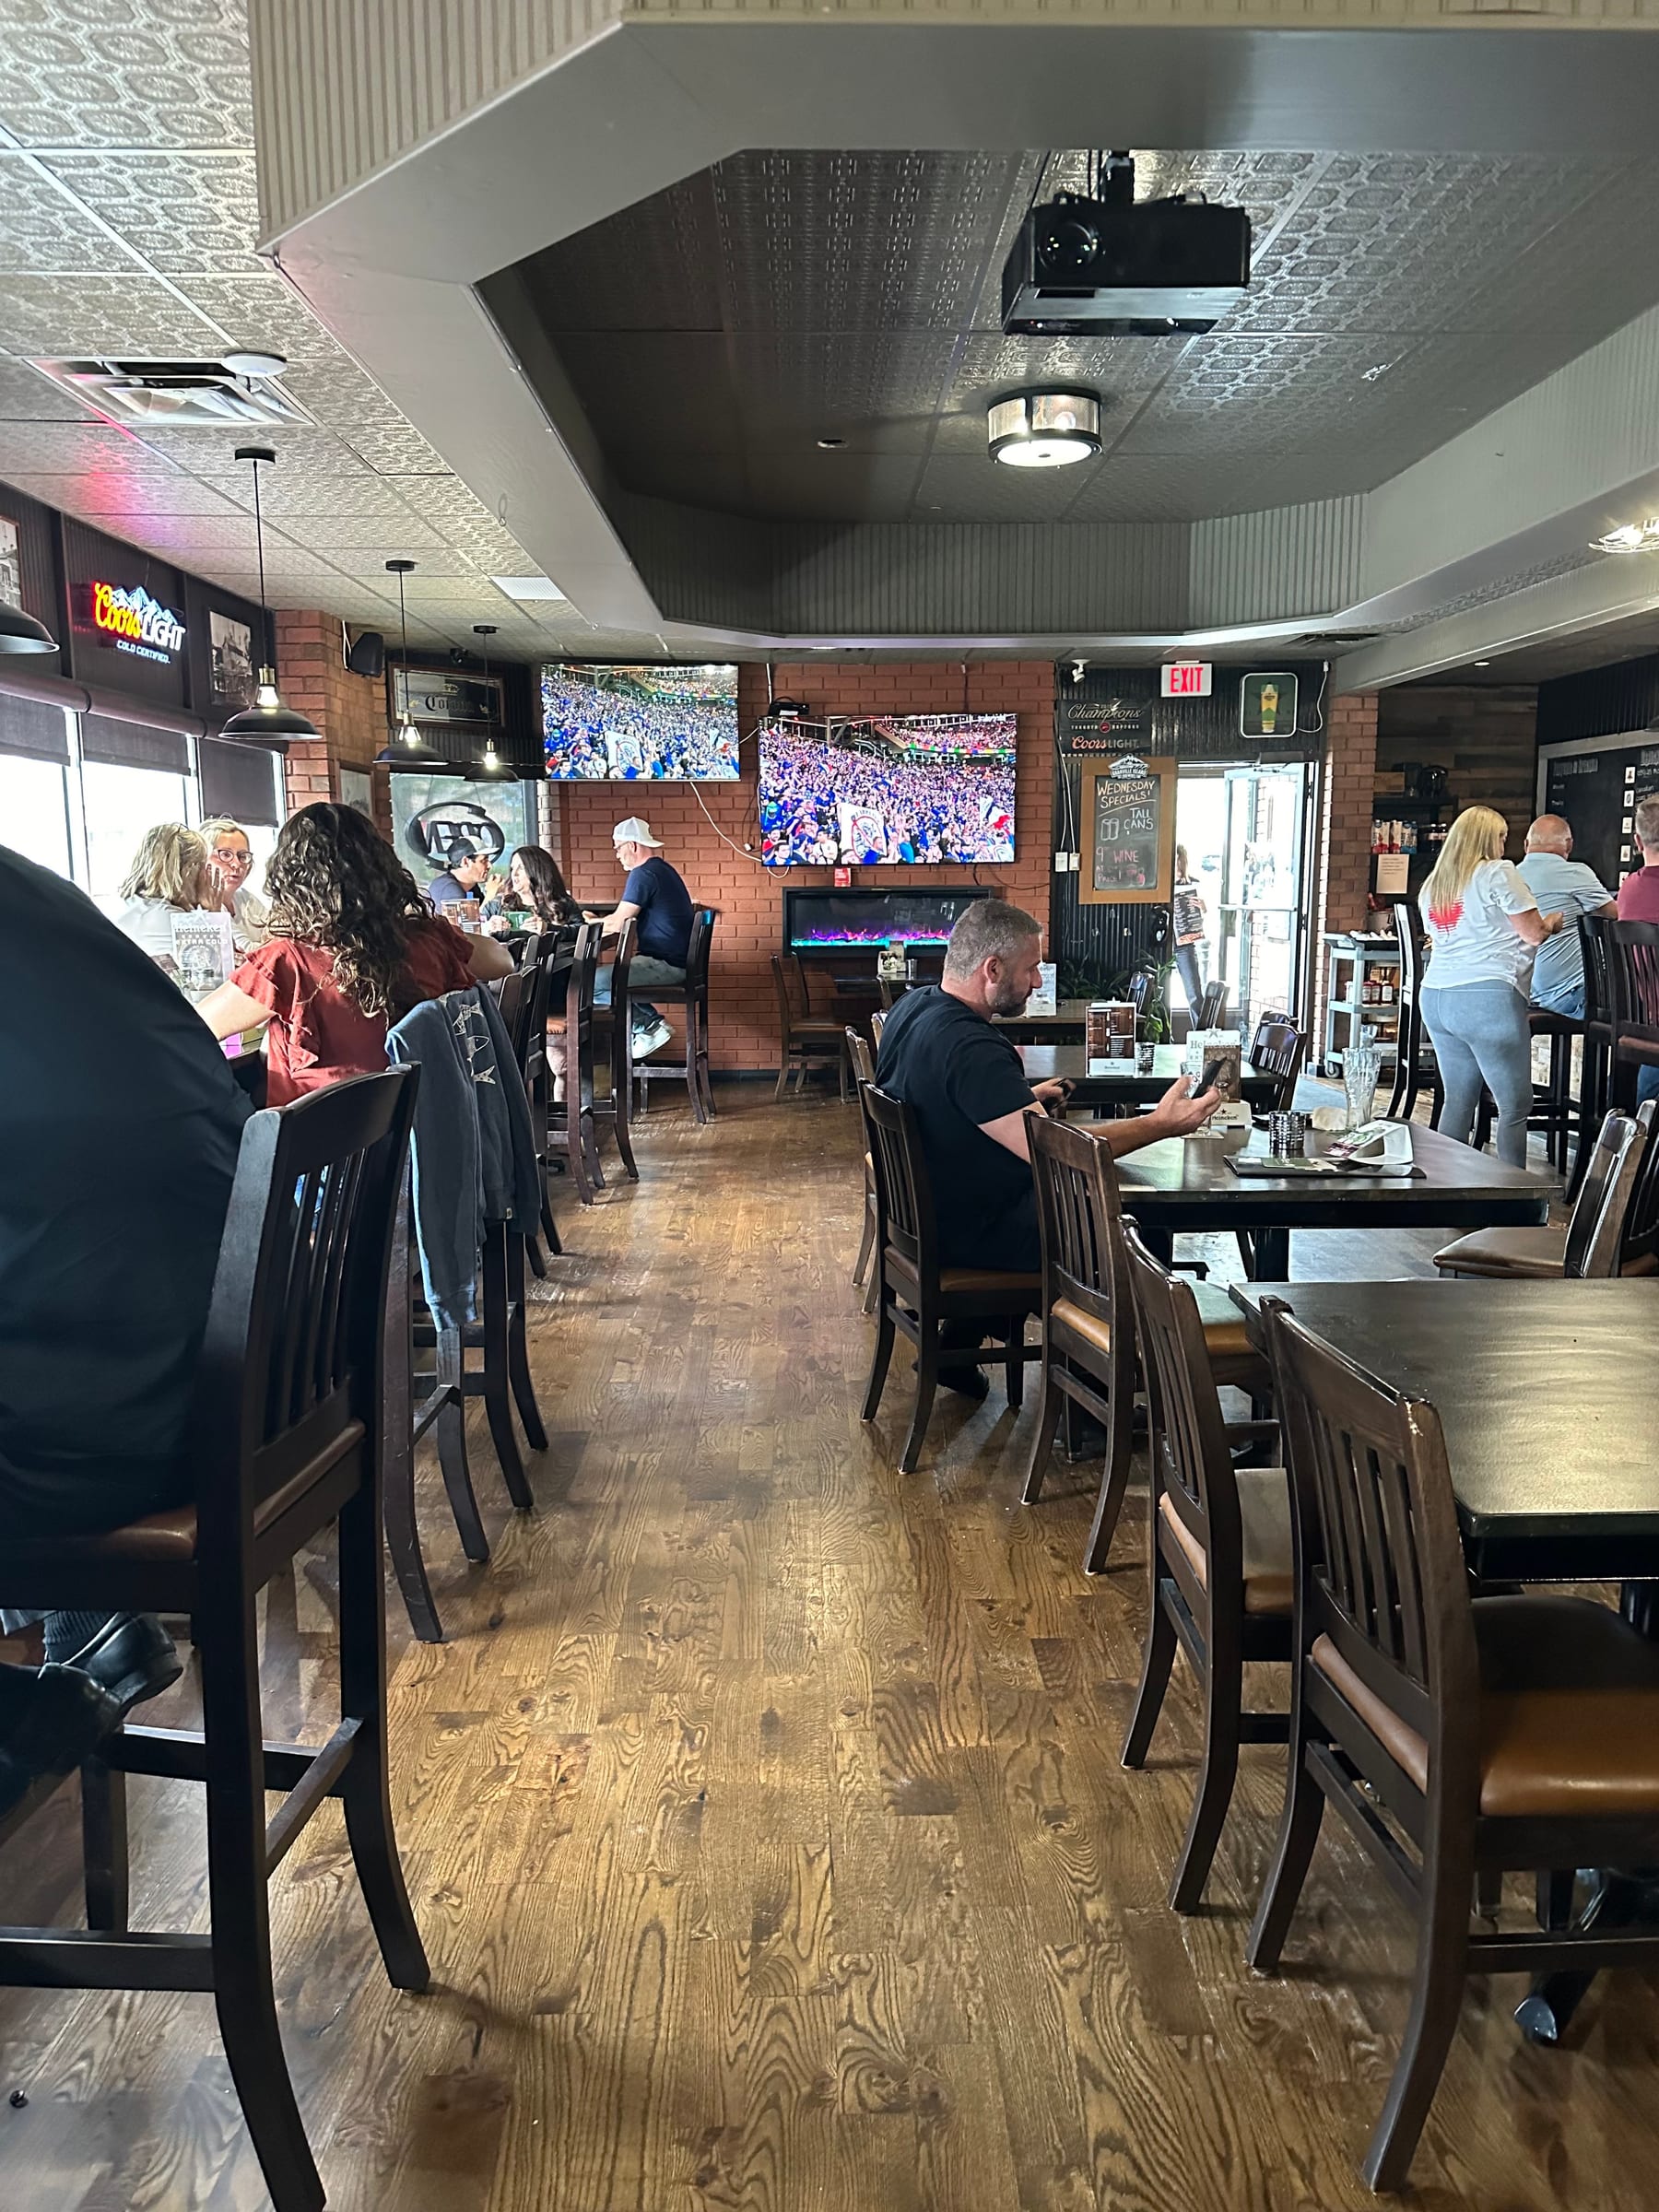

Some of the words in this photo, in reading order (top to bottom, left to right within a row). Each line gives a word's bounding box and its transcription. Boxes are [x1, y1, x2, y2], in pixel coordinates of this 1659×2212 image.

[94, 582, 142, 640] Coors
[141, 612, 186, 651] LIGHT
[116, 640, 136, 653] COLD
[1170, 667, 1204, 693] EXIT
[1067, 703, 1143, 724] Champions
[1071, 736, 1106, 749] Coors
[1097, 780, 1156, 796] WEDNESDAY
[1129, 807, 1151, 819] TALL
[1124, 818, 1154, 830] CANS
[1112, 849, 1140, 864] WINE
